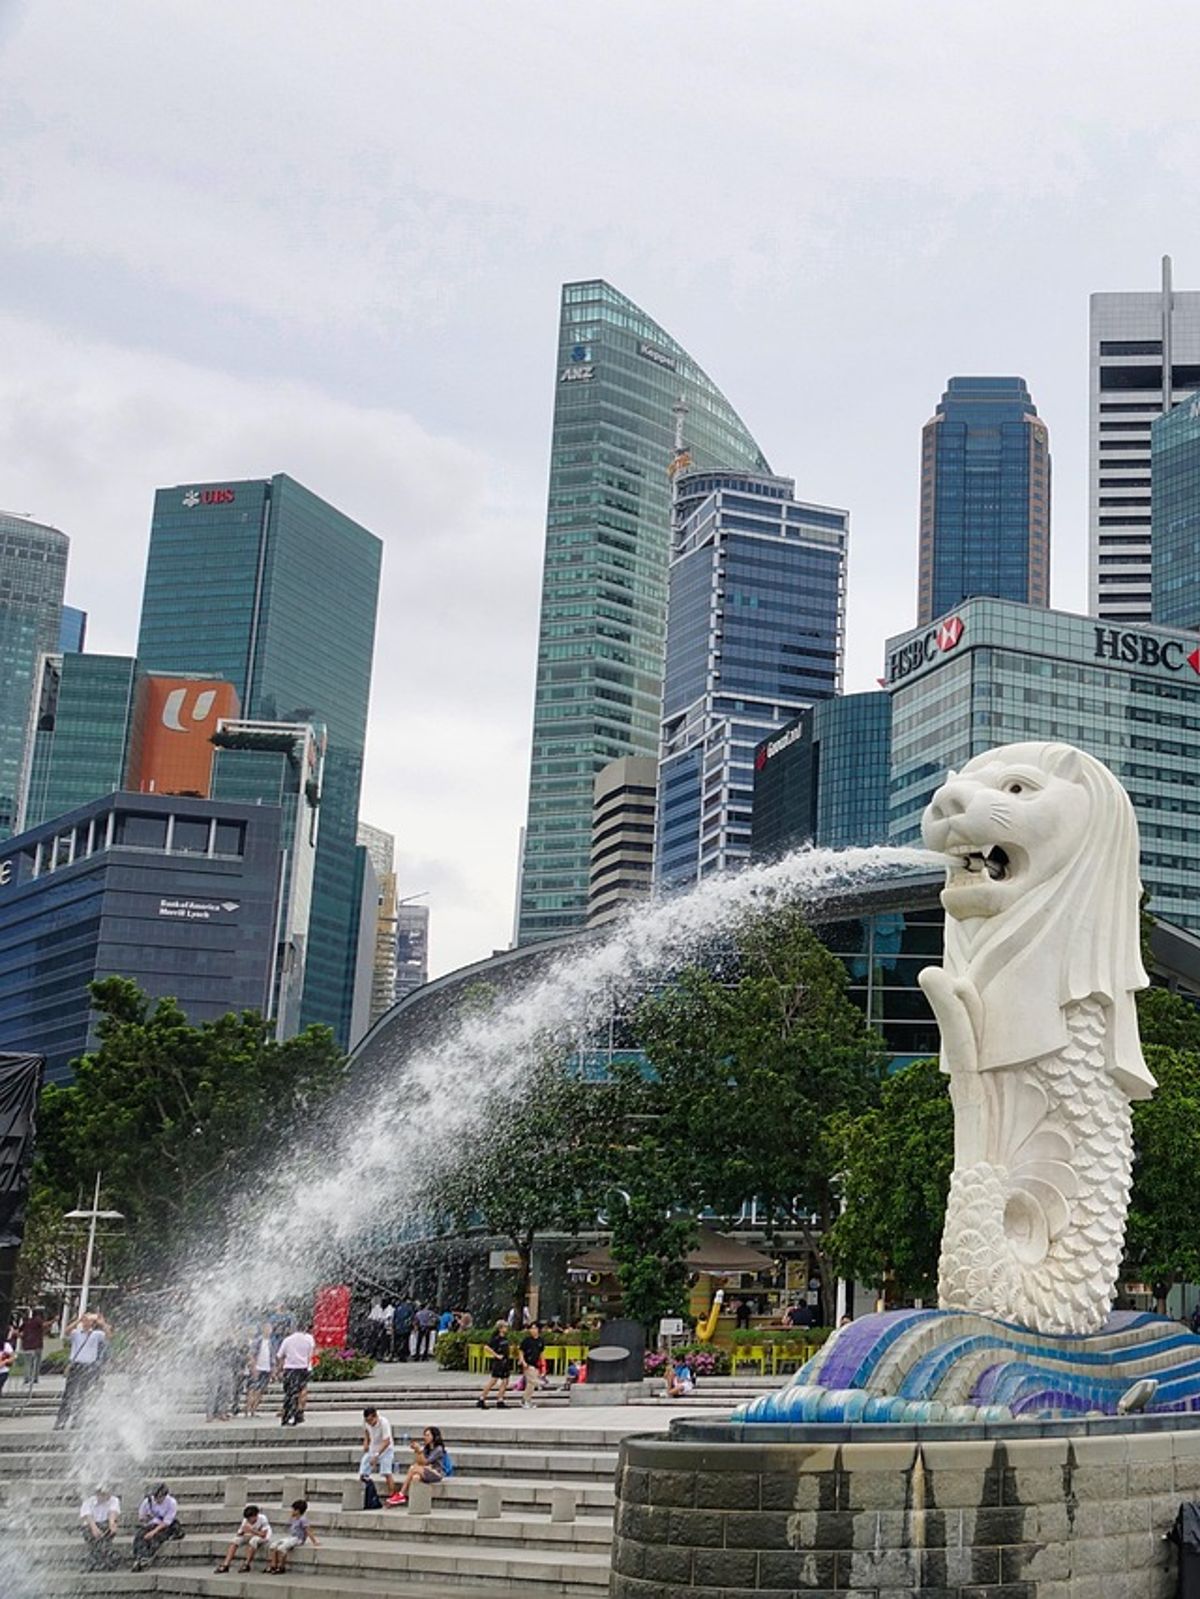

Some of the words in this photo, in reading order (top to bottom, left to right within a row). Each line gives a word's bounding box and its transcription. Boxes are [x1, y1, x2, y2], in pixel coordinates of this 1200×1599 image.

[560, 366, 596, 382] ANZ
[201, 489, 235, 505] UBS
[890, 630, 937, 683] HSBC
[1094, 627, 1184, 671] HSBC
